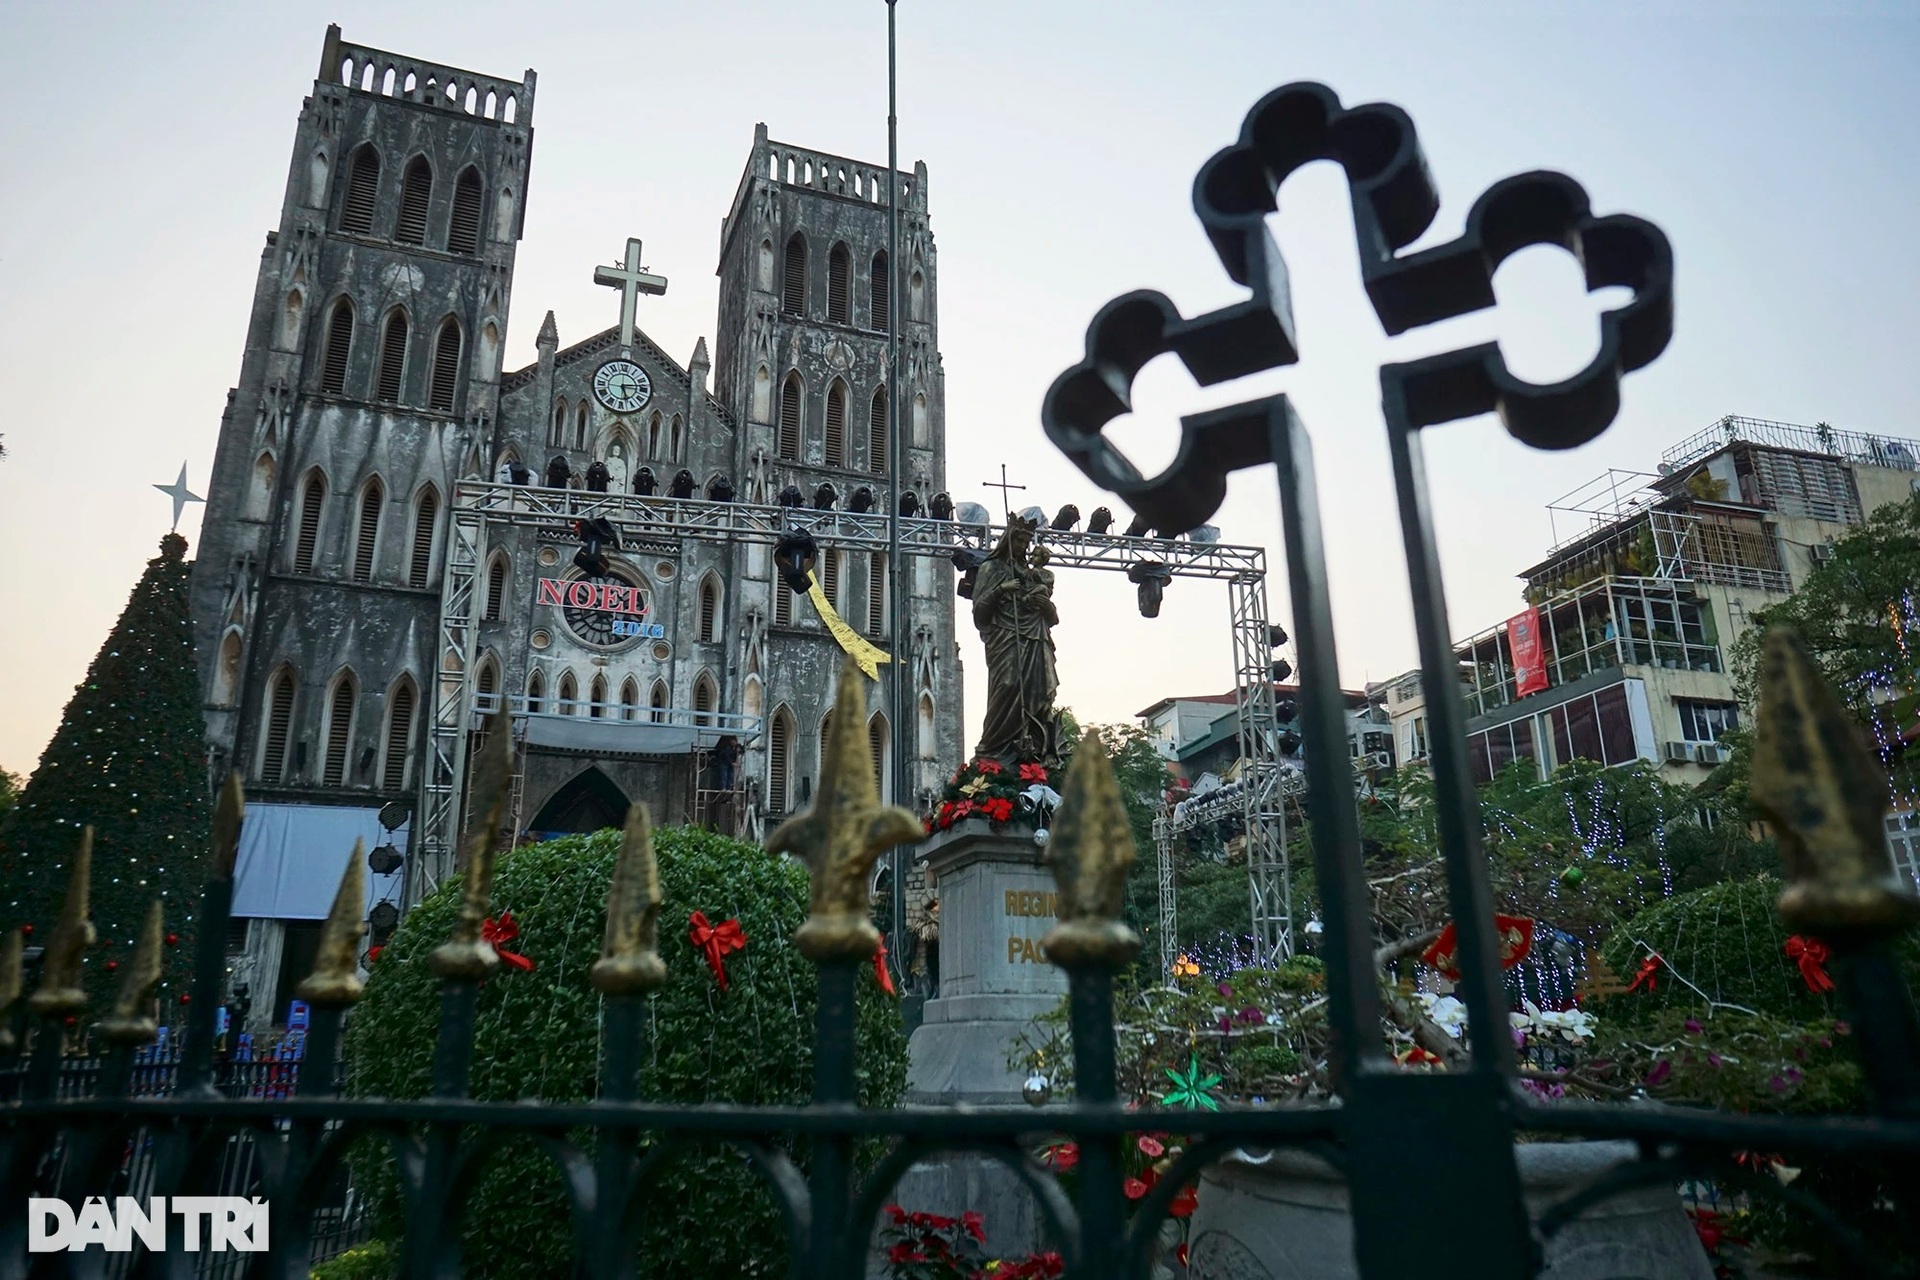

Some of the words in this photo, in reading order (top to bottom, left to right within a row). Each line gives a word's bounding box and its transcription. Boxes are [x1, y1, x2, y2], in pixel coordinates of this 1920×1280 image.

[538, 578, 650, 615] NOEL
[613, 621, 664, 638] 2016
[1005, 889, 1061, 918] REGIN
[1008, 936, 1051, 965] PAC
